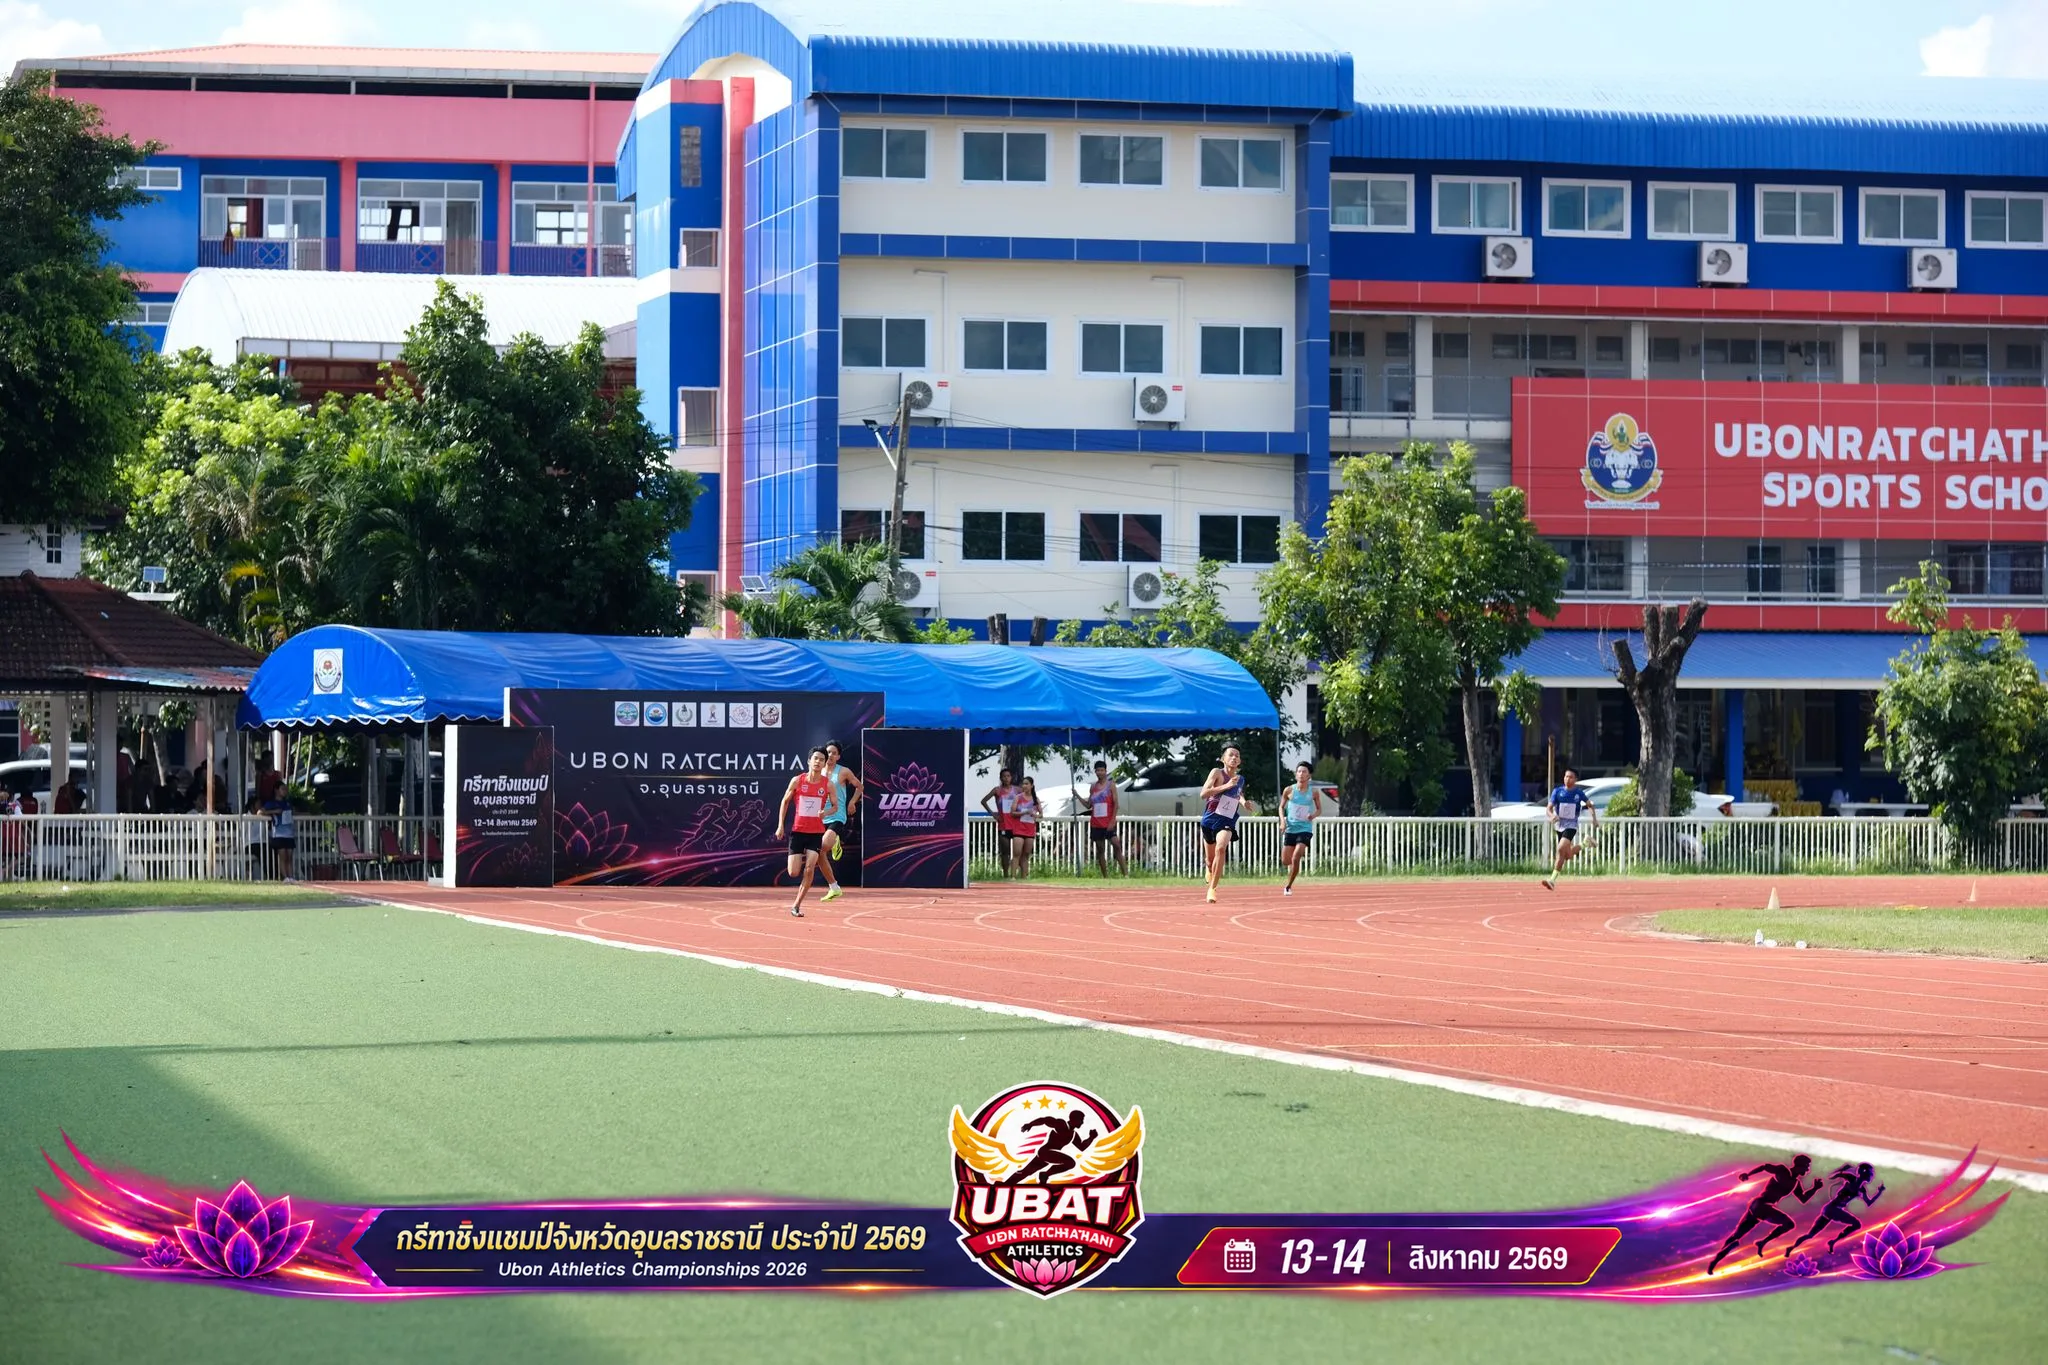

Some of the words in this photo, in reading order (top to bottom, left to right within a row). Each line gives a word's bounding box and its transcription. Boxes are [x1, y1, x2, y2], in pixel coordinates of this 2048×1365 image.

[1763, 471, 1922, 509] SPORTS
[1945, 474, 2048, 511] SCHO
[570, 752, 648, 769] UBON
[639, 781, 759, 799] จ.อุบลราชธานี
[879, 793, 952, 809] UBON
[521, 818, 538, 827] 2569
[880, 810, 948, 819] ATHLETICS
